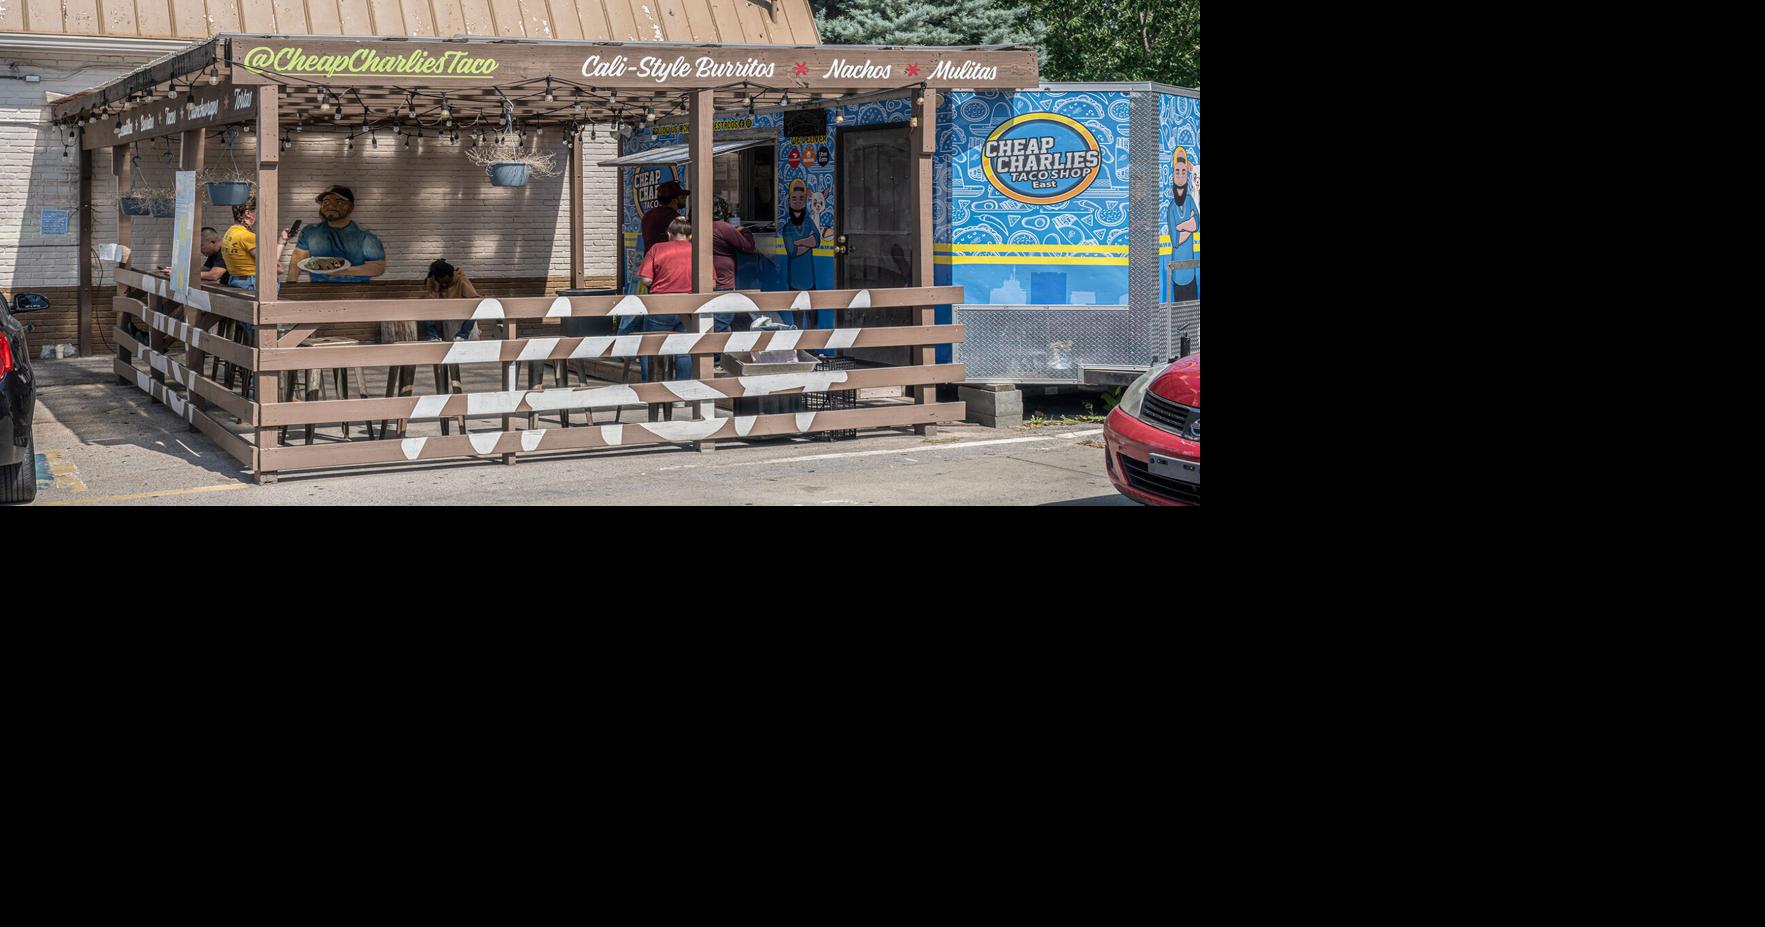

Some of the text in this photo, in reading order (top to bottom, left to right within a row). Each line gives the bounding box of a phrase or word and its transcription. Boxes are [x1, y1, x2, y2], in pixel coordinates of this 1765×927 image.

[243, 46, 499, 78] @CheapCharliesTaco
[581, 55, 776, 83] Cali-Style Burritos
[822, 58, 892, 80] Nachos
[927, 60, 998, 81] Mulitas
[233, 88, 253, 111] Tortas
[984, 136, 1055, 158] CHEAP
[996, 150, 1101, 174] CHARLIES
[634, 170, 661, 188] CHEAP
[1010, 167, 1093, 182] TACO SHOP
[1032, 180, 1057, 190] East
